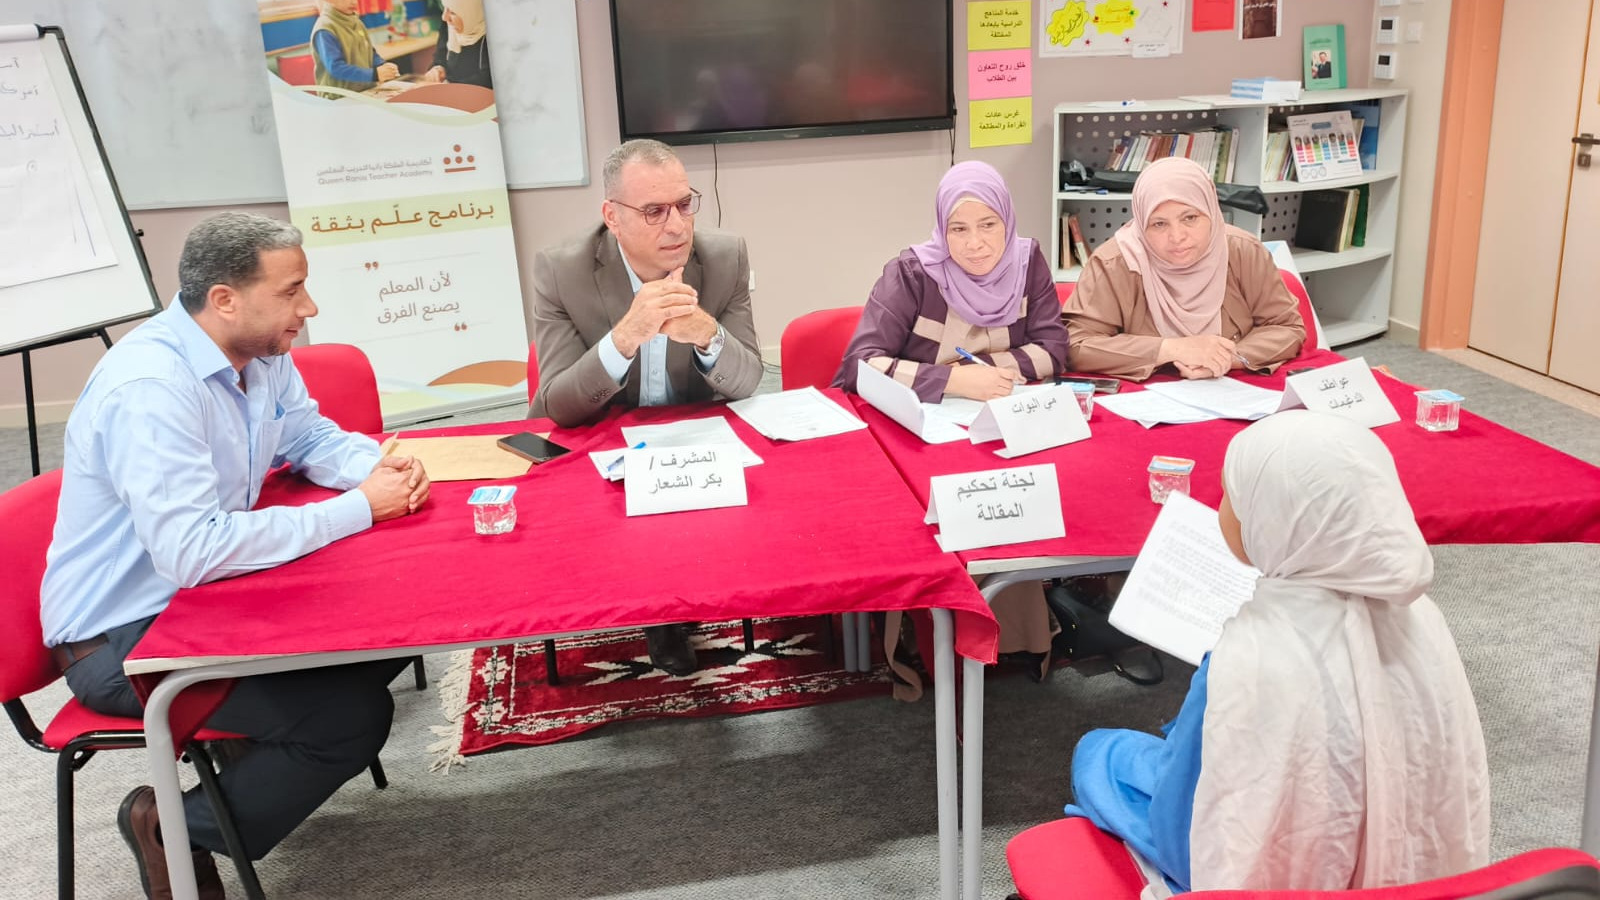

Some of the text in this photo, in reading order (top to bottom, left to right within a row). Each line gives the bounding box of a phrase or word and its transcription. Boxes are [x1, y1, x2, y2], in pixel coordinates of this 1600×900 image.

[977, 63, 998, 72] التعاون
[999, 63, 1013, 72] روح
[987, 74, 1017, 82] بين الطلاب
[318, 177, 344, 185] Queen
[368, 172, 398, 181] Teacher
[400, 170, 433, 178] Academy
[311, 214, 365, 233] بثقة
[428, 202, 494, 227] برنامج
[379, 271, 451, 302] لأن المعلم
[377, 301, 460, 324] يصنع الفرق
[1044, 397, 1057, 410] مي
[660, 451, 717, 469] المشرف
[648, 473, 722, 494] بكر الشعار
[957, 472, 1035, 501] لجنة تحكيم
[977, 502, 1024, 521] المقالة
